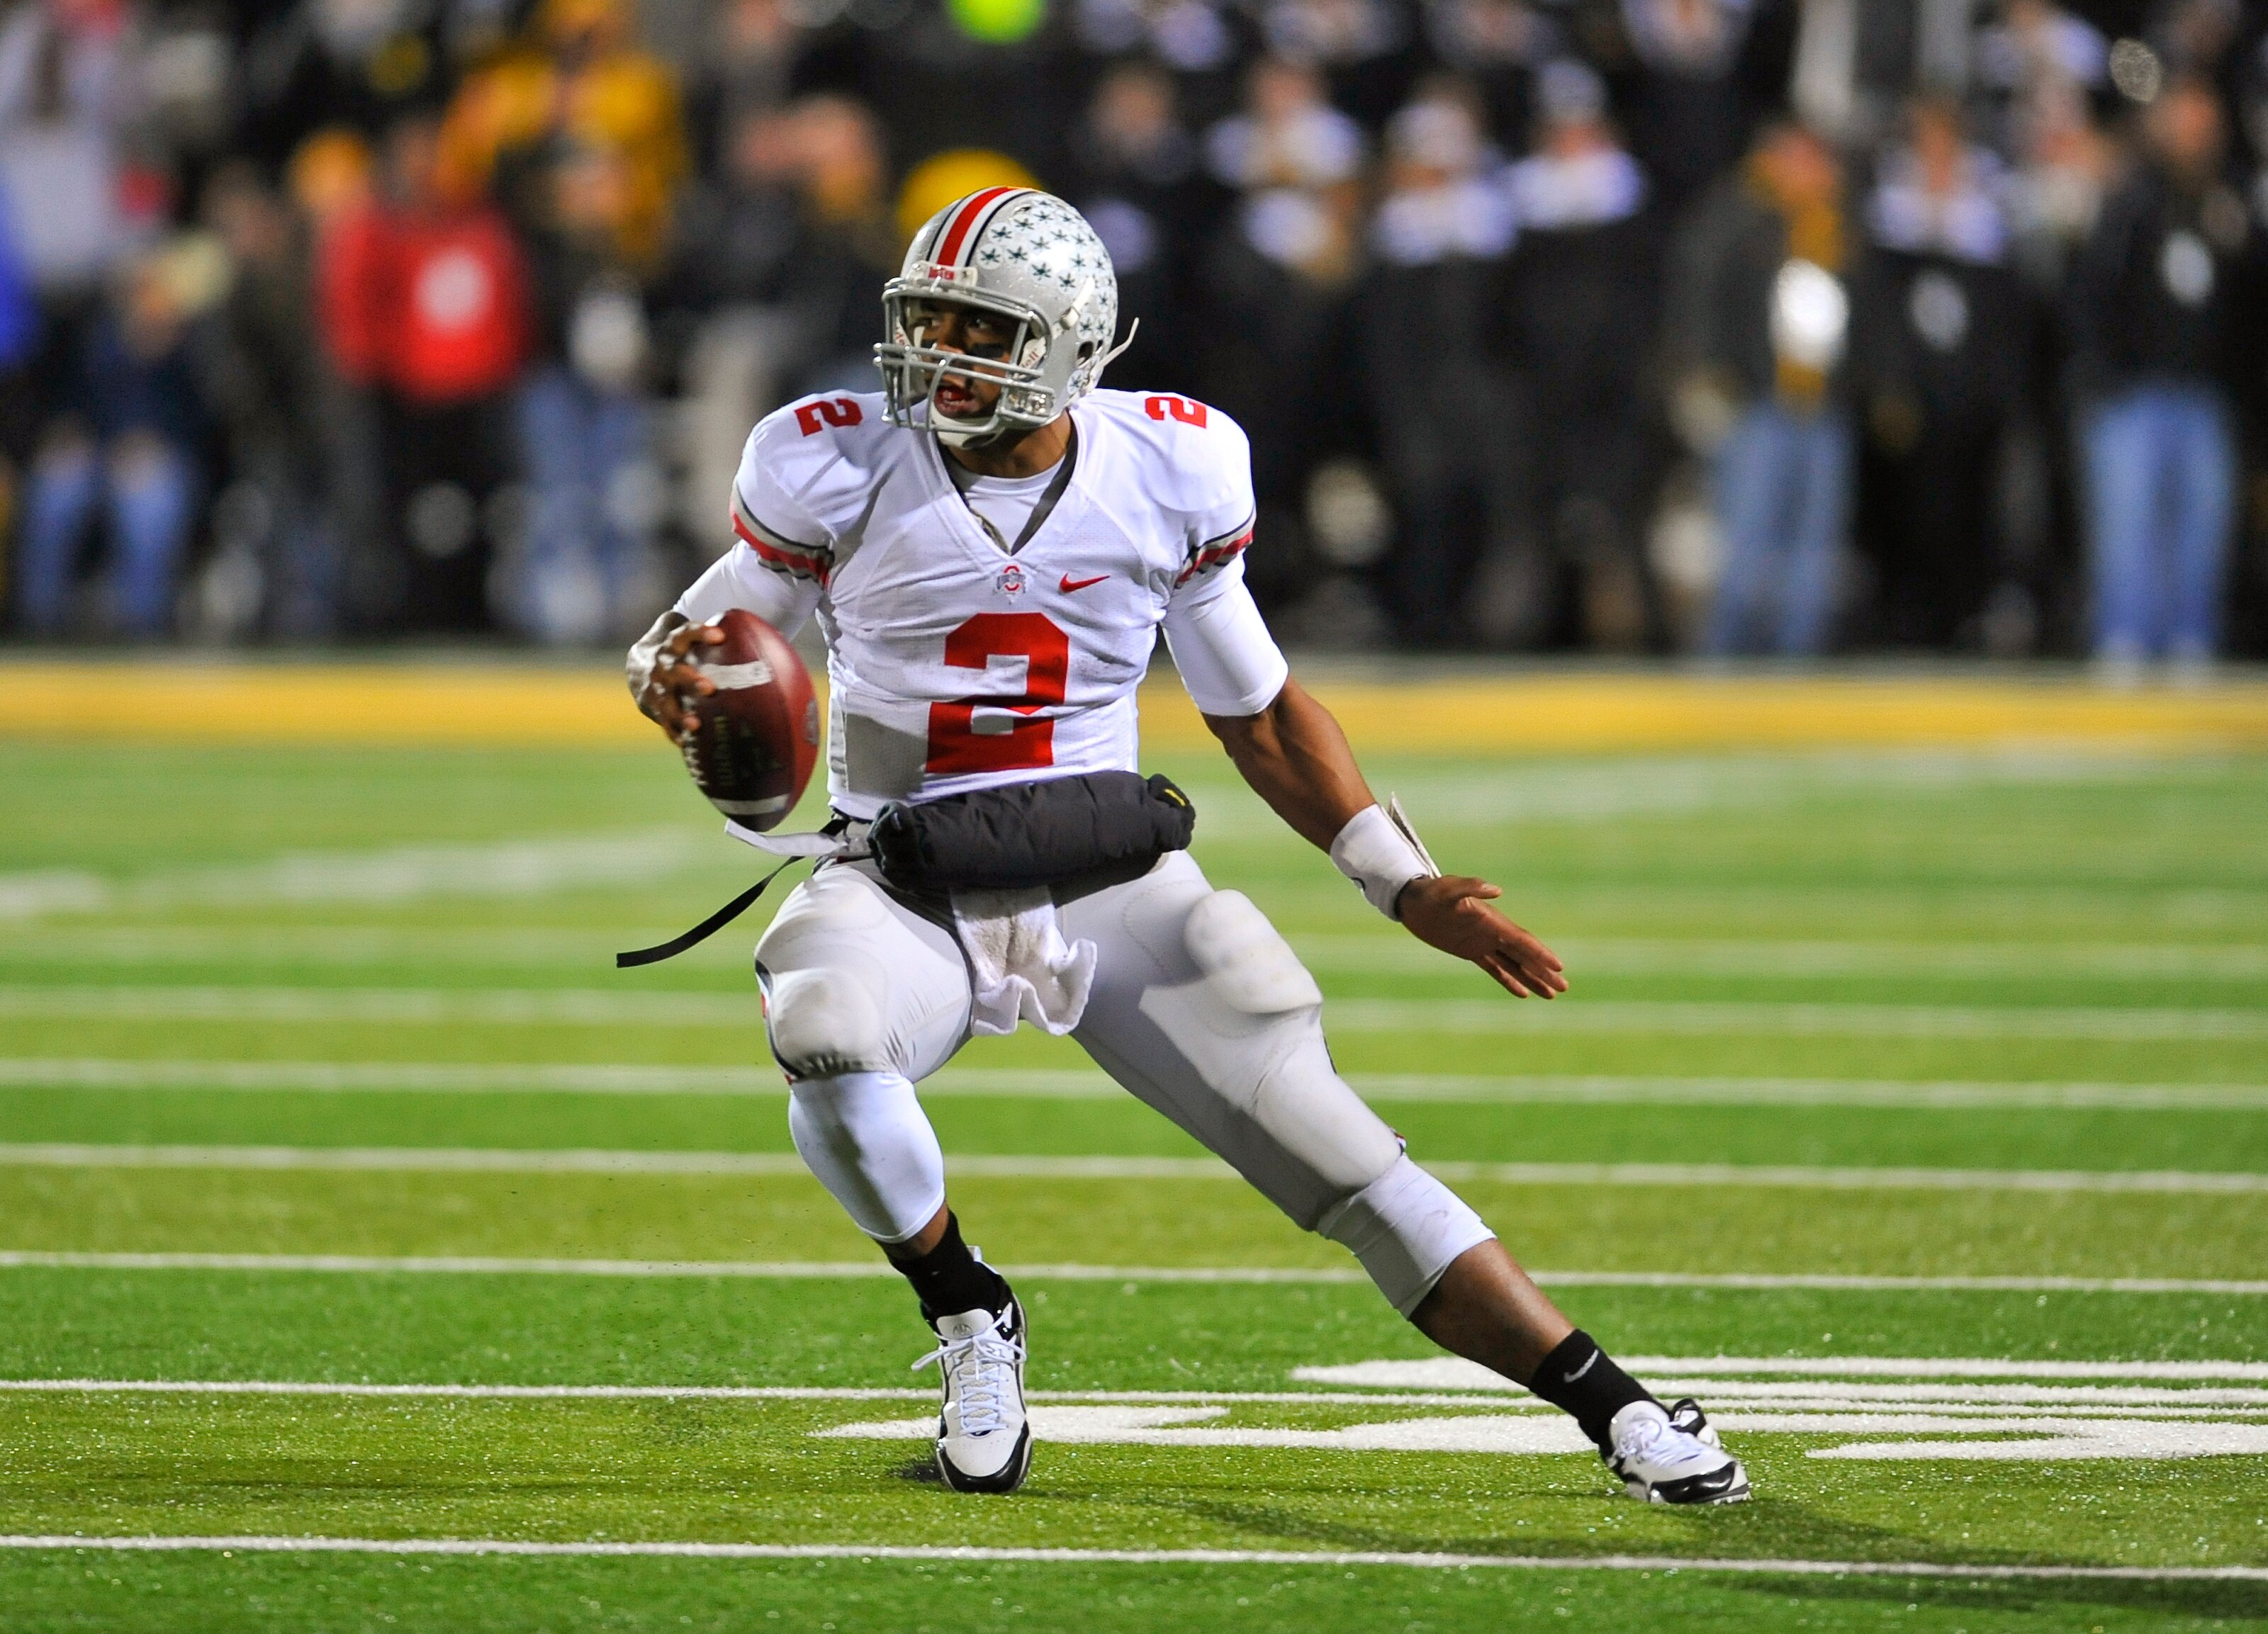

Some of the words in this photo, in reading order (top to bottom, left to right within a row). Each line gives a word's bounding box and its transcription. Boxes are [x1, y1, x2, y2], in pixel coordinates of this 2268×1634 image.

[795, 398, 863, 436] 2
[1145, 397, 1206, 429] 2
[926, 612, 1069, 773] 2
